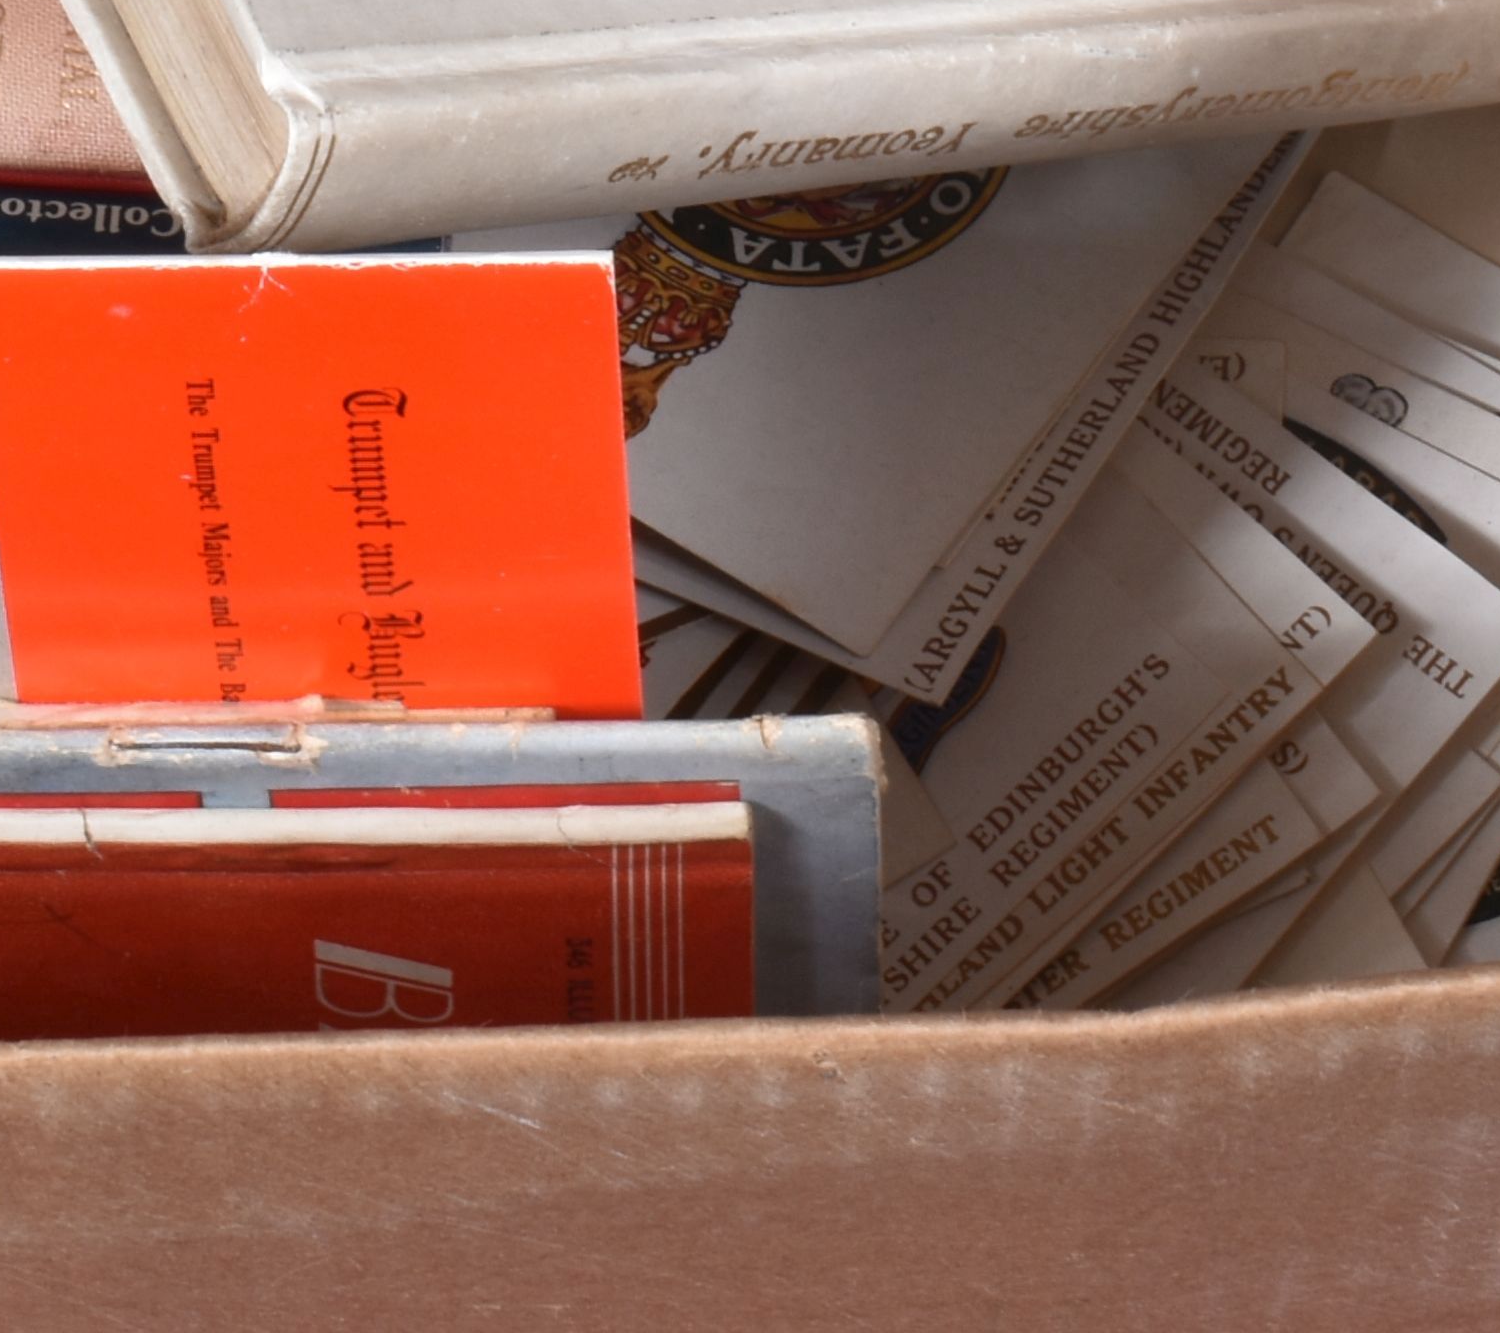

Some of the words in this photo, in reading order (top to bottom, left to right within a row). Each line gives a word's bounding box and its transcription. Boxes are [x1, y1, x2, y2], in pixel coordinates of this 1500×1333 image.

[185, 377, 214, 418] The
[187, 427, 221, 513] Trumpet
[329, 386, 409, 530] Trumpet
[200, 521, 232, 588] Majors
[903, 563, 1008, 694] (ARGYLL
[993, 531, 1027, 557] &
[1013, 332, 1162, 527] SUTHERLAND
[208, 594, 240, 629] and
[357, 542, 415, 598] and
[214, 636, 244, 673] The
[1401, 633, 1475, 700] THE
[910, 859, 954, 910] OF
[965, 652, 1170, 854] EDINBURGH'S
[987, 723, 1160, 889] REGIMENT)
[1025, 816, 1131, 915] LIGHT
[1131, 665, 1295, 820] INFANTRY
[1100, 813, 1282, 953] REGIMENT
